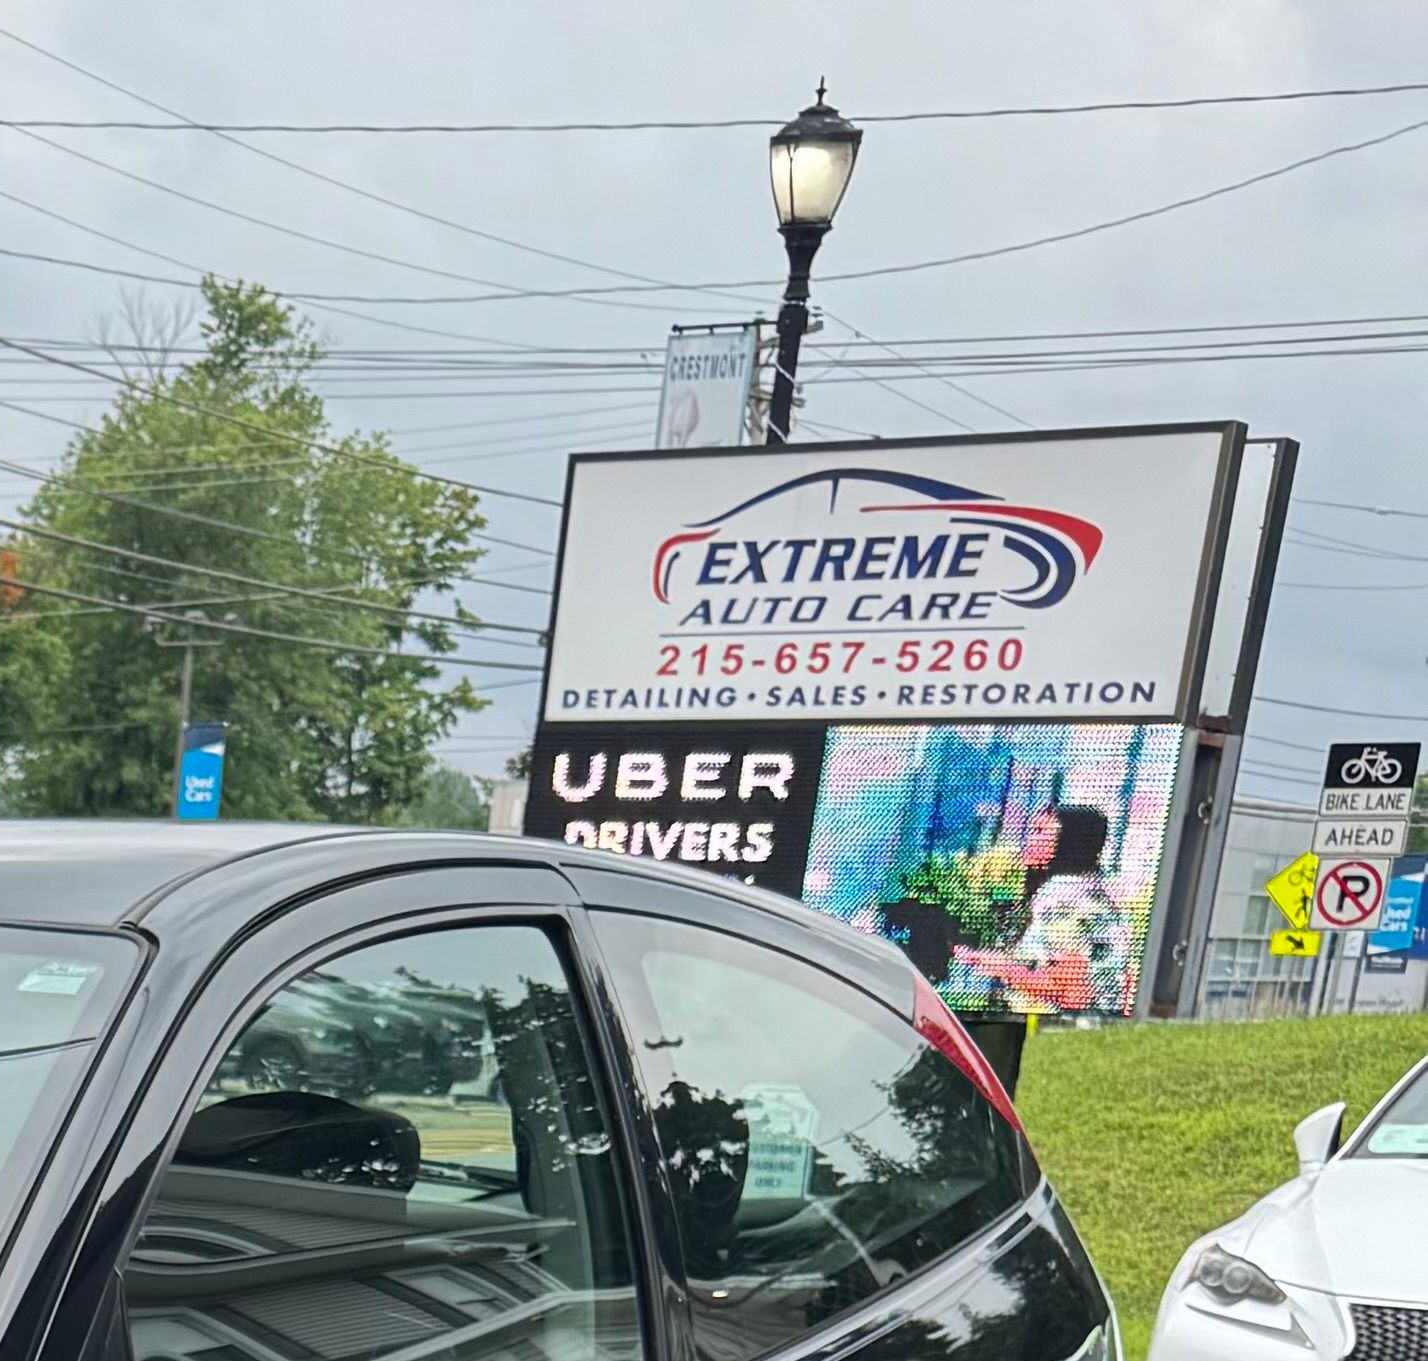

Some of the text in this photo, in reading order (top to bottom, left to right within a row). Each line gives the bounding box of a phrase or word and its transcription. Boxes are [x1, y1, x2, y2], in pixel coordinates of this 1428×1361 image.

[670, 353, 746, 381] CRESTMONT
[696, 533, 989, 587] EXTREME
[678, 592, 998, 626] AUTO CARE
[656, 638, 1024, 677] 215-657-5260
[563, 681, 1156, 710] DETAILING SALES RESTORATION
[551, 751, 796, 803] UBER
[1324, 793, 1407, 812] BIKE LANE
[564, 819, 776, 863] DRIVERS
[1324, 827, 1394, 848] AHEAD
[752, 1142, 802, 1156] USTOMER
